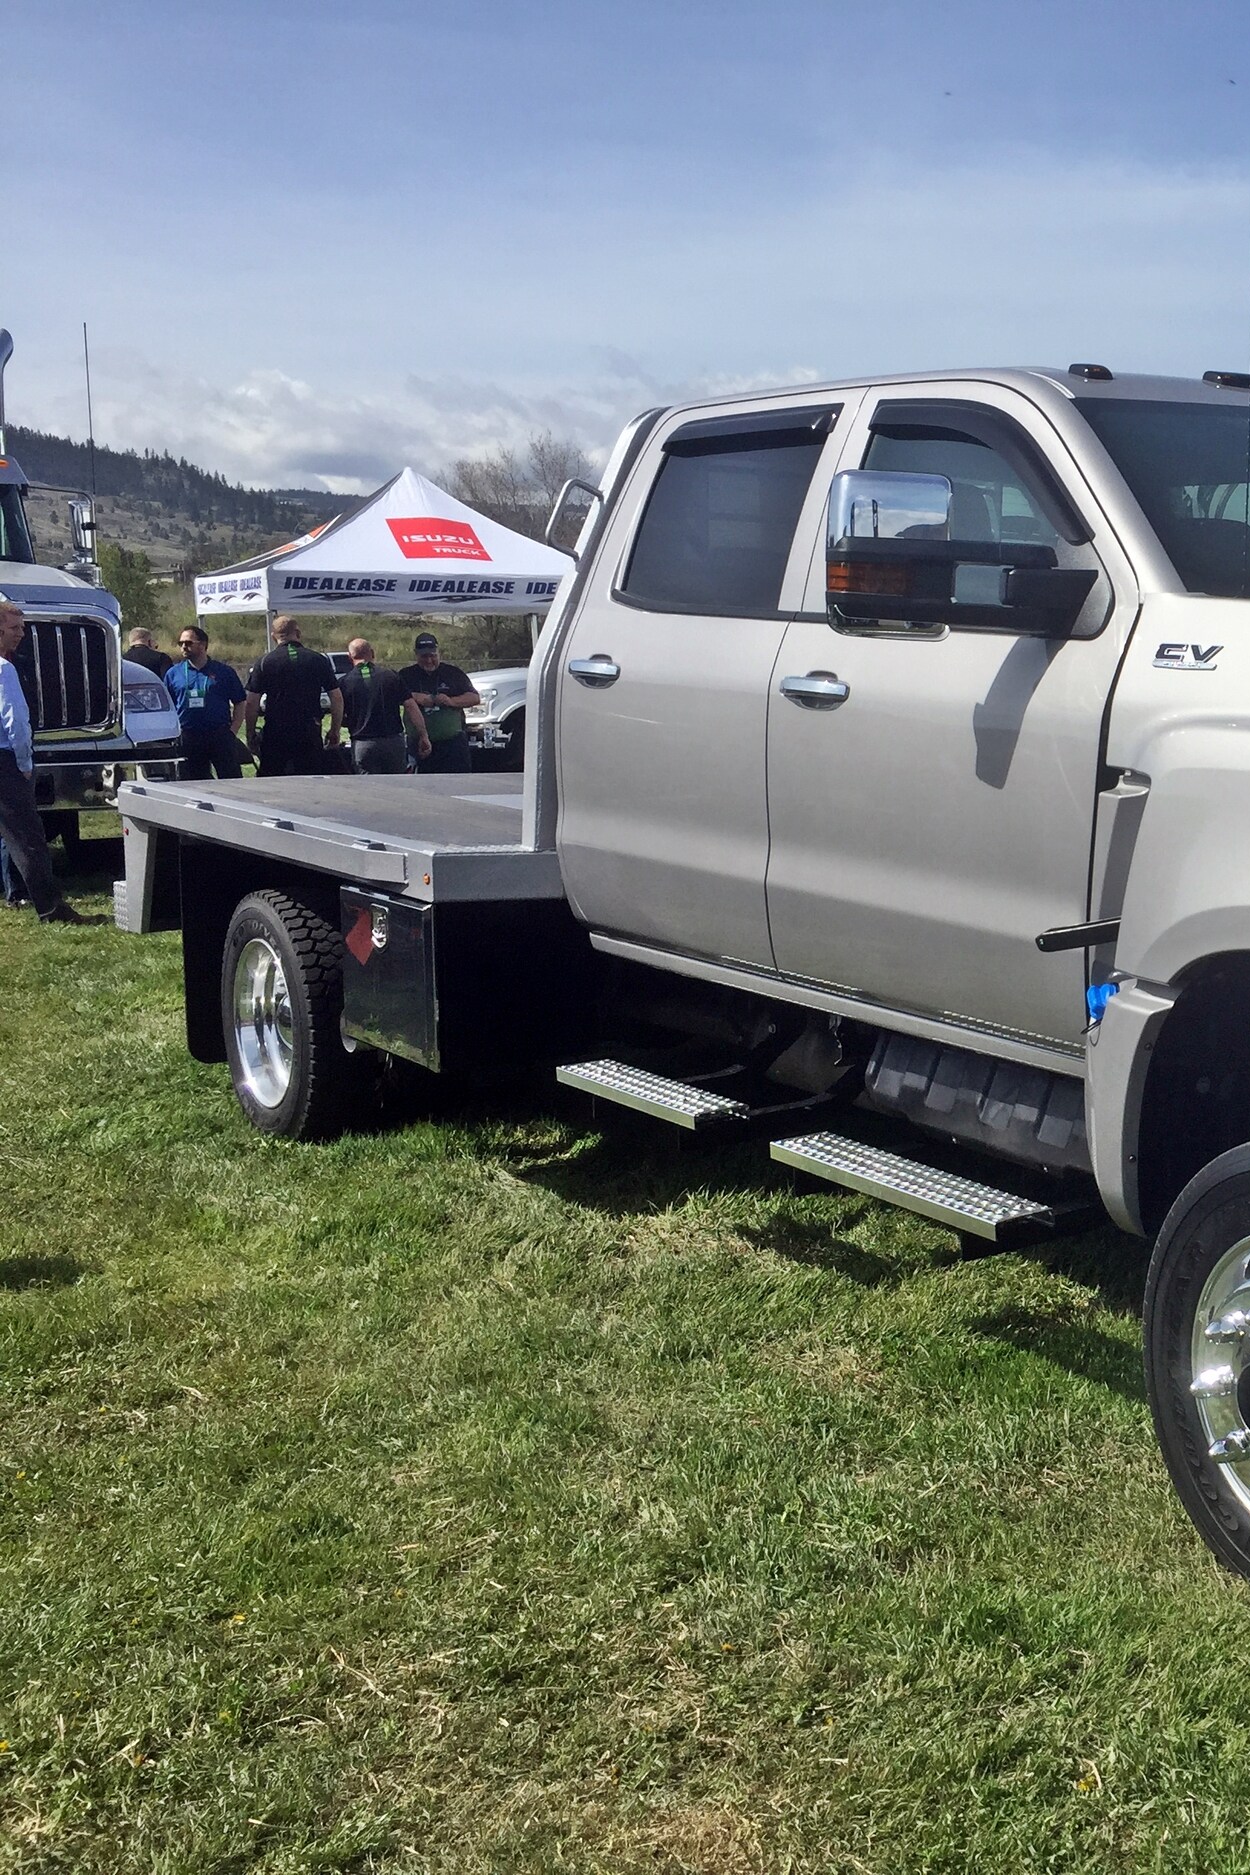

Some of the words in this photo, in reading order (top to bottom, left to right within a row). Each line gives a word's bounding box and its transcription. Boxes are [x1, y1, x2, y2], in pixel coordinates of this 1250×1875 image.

[401, 534, 475, 546] ISUZU
[432, 546, 481, 556] TRUCK
[284, 576, 398, 592] IDEALEASE
[408, 579, 516, 594] IDEALEASE
